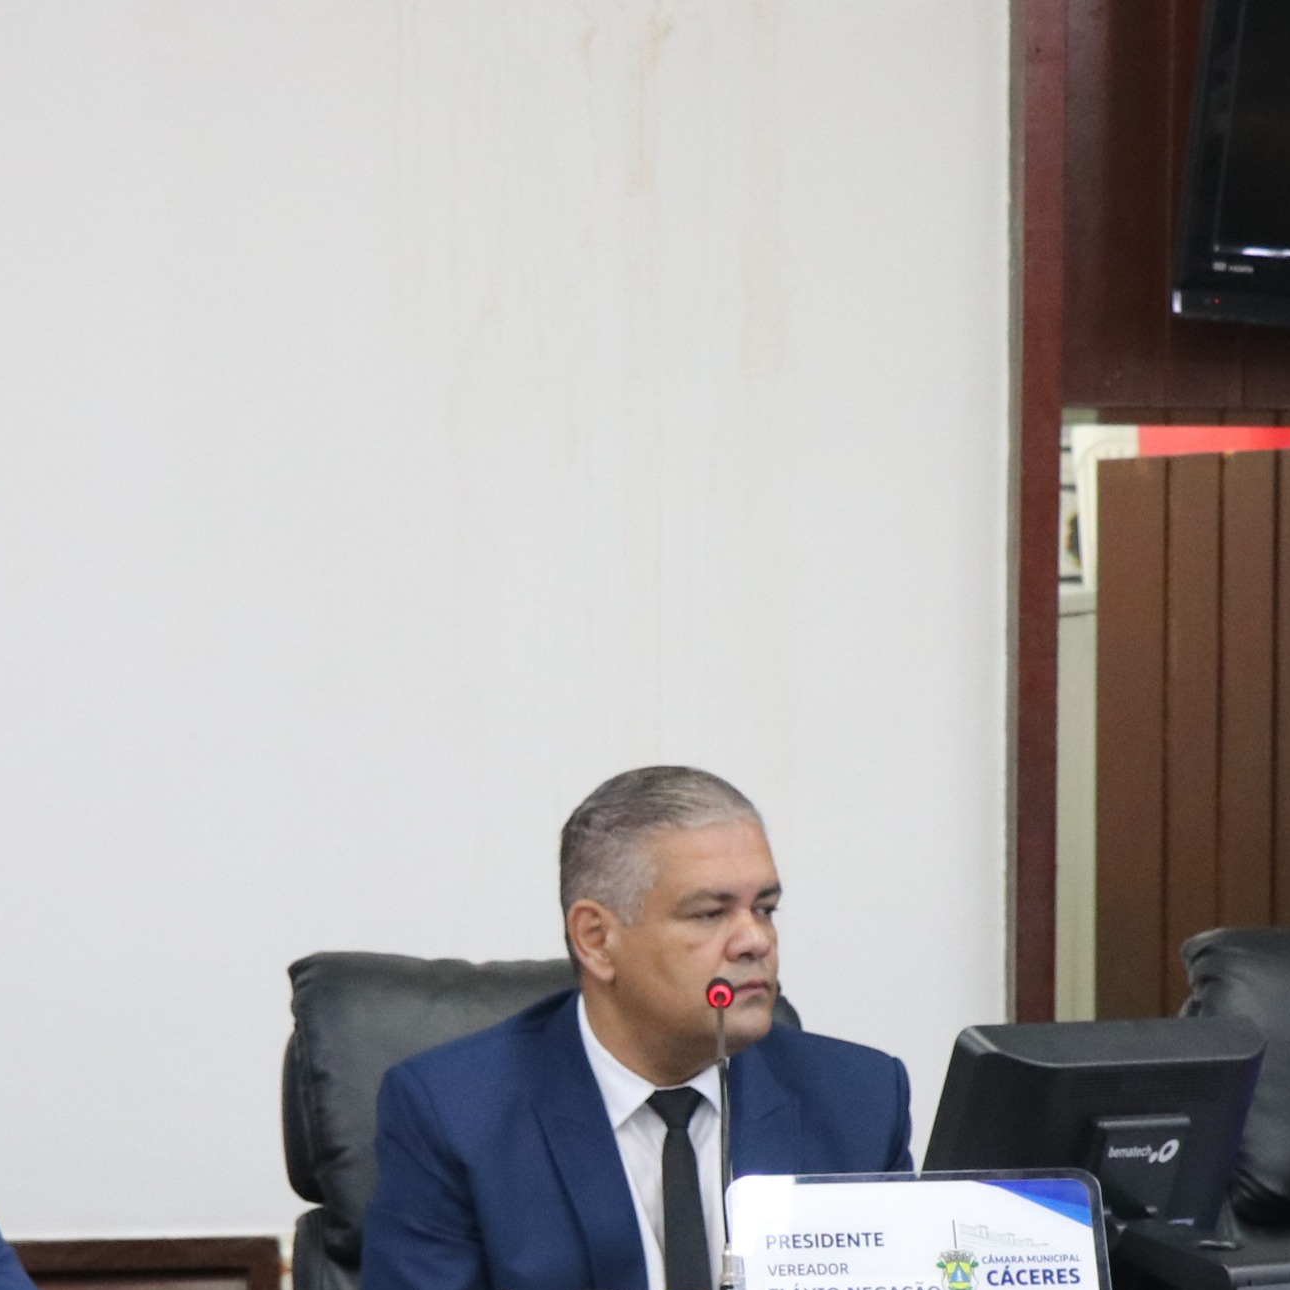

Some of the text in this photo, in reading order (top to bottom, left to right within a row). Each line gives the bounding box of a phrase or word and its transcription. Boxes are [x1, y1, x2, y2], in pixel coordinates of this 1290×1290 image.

[765, 1232, 885, 1249] PRESIDENTE
[981, 1253, 1081, 1264] CÂMARA MUNICIPAL
[767, 1263, 849, 1276] VEREADOR
[987, 1265, 1081, 1286] CÁCERES
